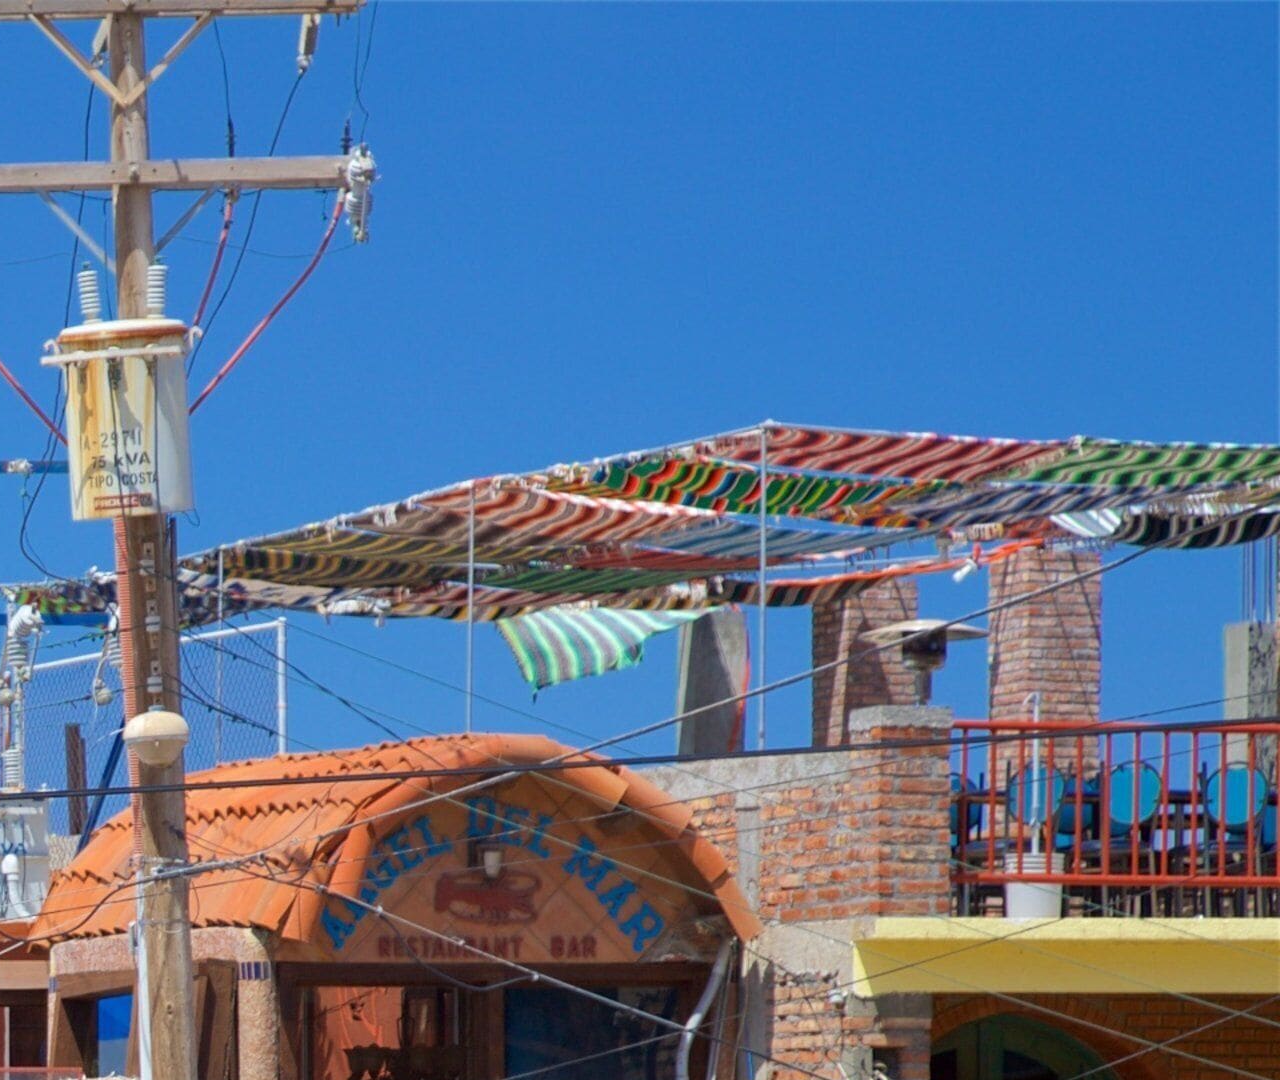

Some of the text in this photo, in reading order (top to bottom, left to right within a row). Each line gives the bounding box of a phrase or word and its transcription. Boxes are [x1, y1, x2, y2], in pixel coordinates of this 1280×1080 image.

[91, 455, 107, 469] 75
[89, 471, 158, 488] TIPO COSTA
[319, 796, 665, 953] ANGEL DEL MAR
[377, 935, 597, 959] RESTAURANT BAR
